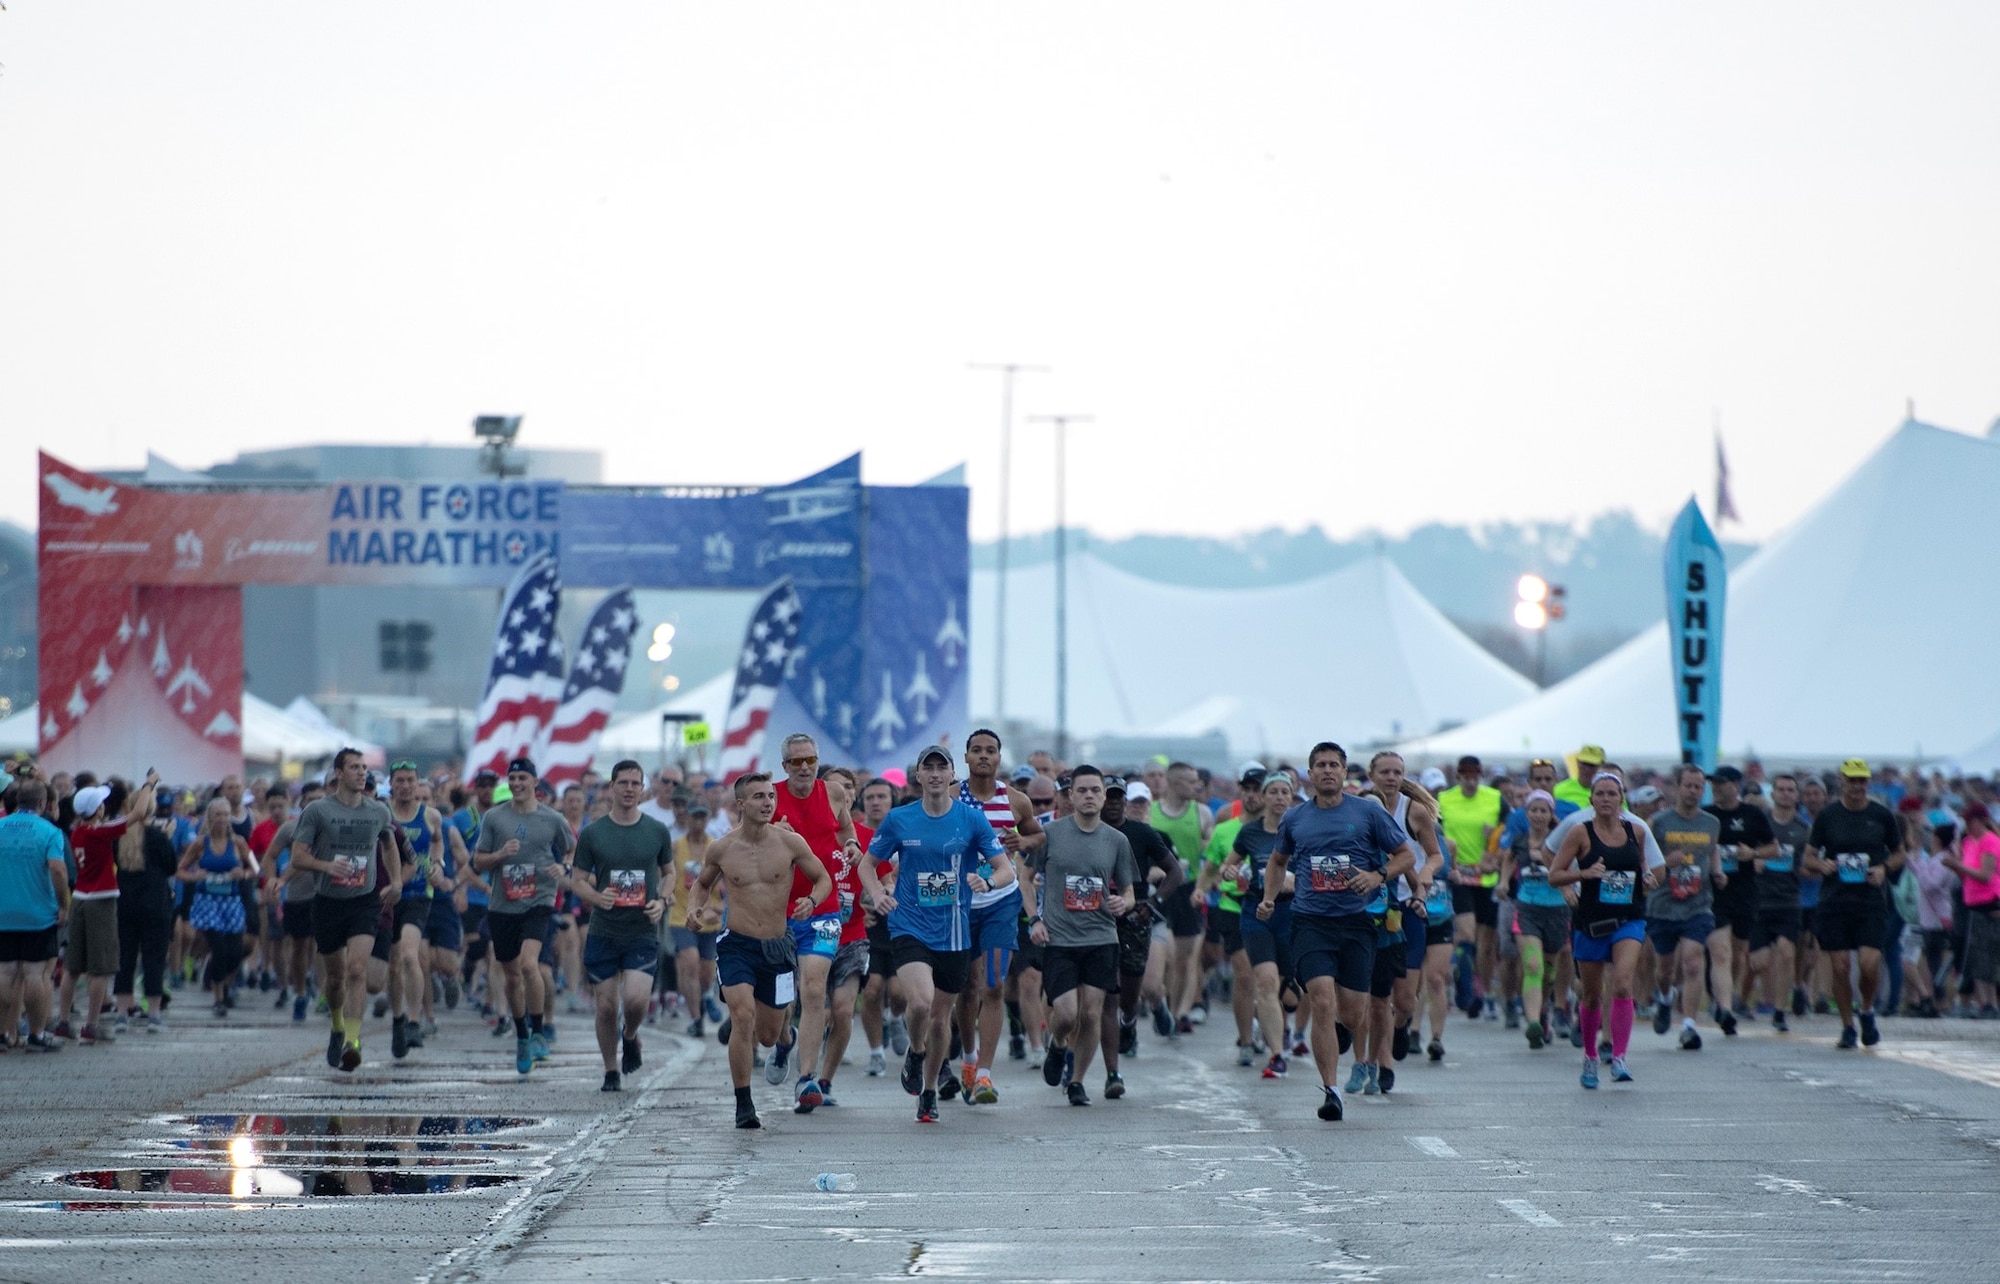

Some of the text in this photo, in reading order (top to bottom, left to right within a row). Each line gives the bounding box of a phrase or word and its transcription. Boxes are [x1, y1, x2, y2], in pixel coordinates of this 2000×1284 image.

[331, 482, 559, 521] AIR FORCE
[327, 530, 559, 565] MARATHON
[330, 817, 346, 825] AIR
[837, 882, 851, 890] 2020
